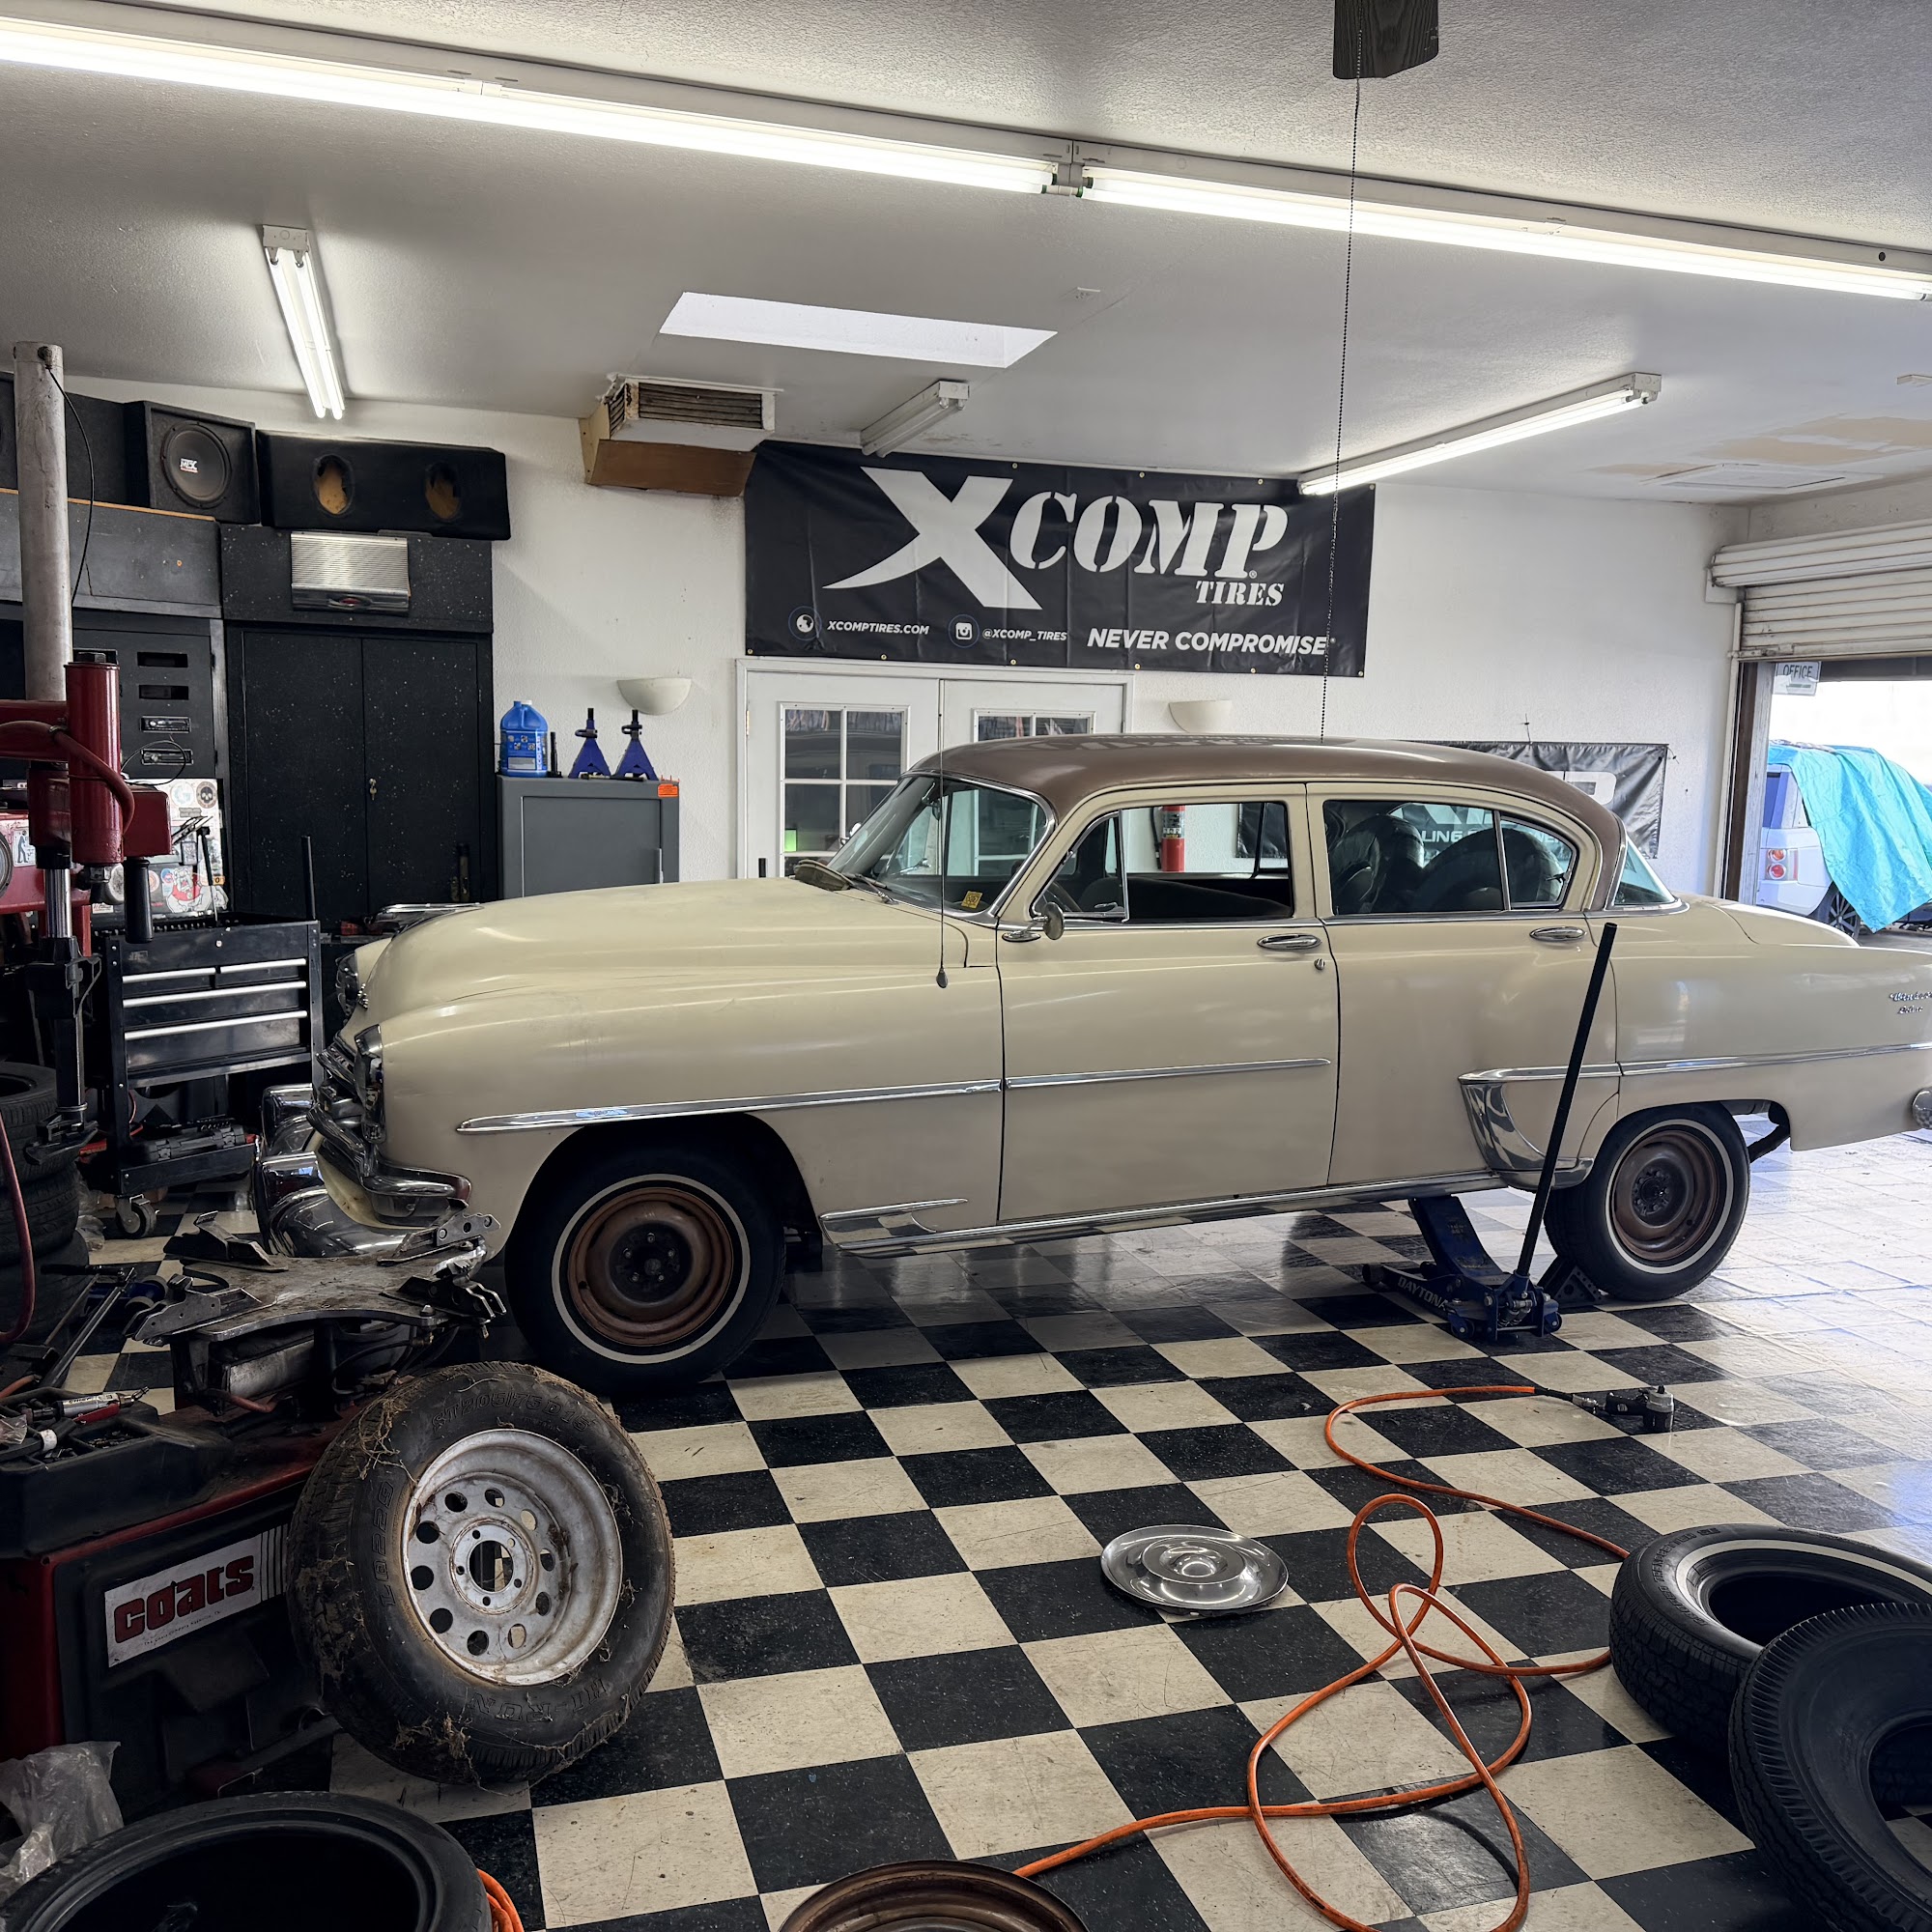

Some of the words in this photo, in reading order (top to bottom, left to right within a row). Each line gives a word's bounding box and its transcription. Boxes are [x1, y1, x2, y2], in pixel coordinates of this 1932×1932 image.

[822, 466, 1289, 611] XCOMP
[1195, 580, 1285, 607] TIRES
[827, 620, 930, 636] XCOMPTIRES.COM
[981, 628, 1068, 641] @XCOMP_TIRES
[1087, 627, 1171, 650] NEVER
[1174, 631, 1329, 656] COMPROMISE
[1782, 664, 1813, 679] OFFICE
[1398, 1276, 1449, 1311] DAYTONA
